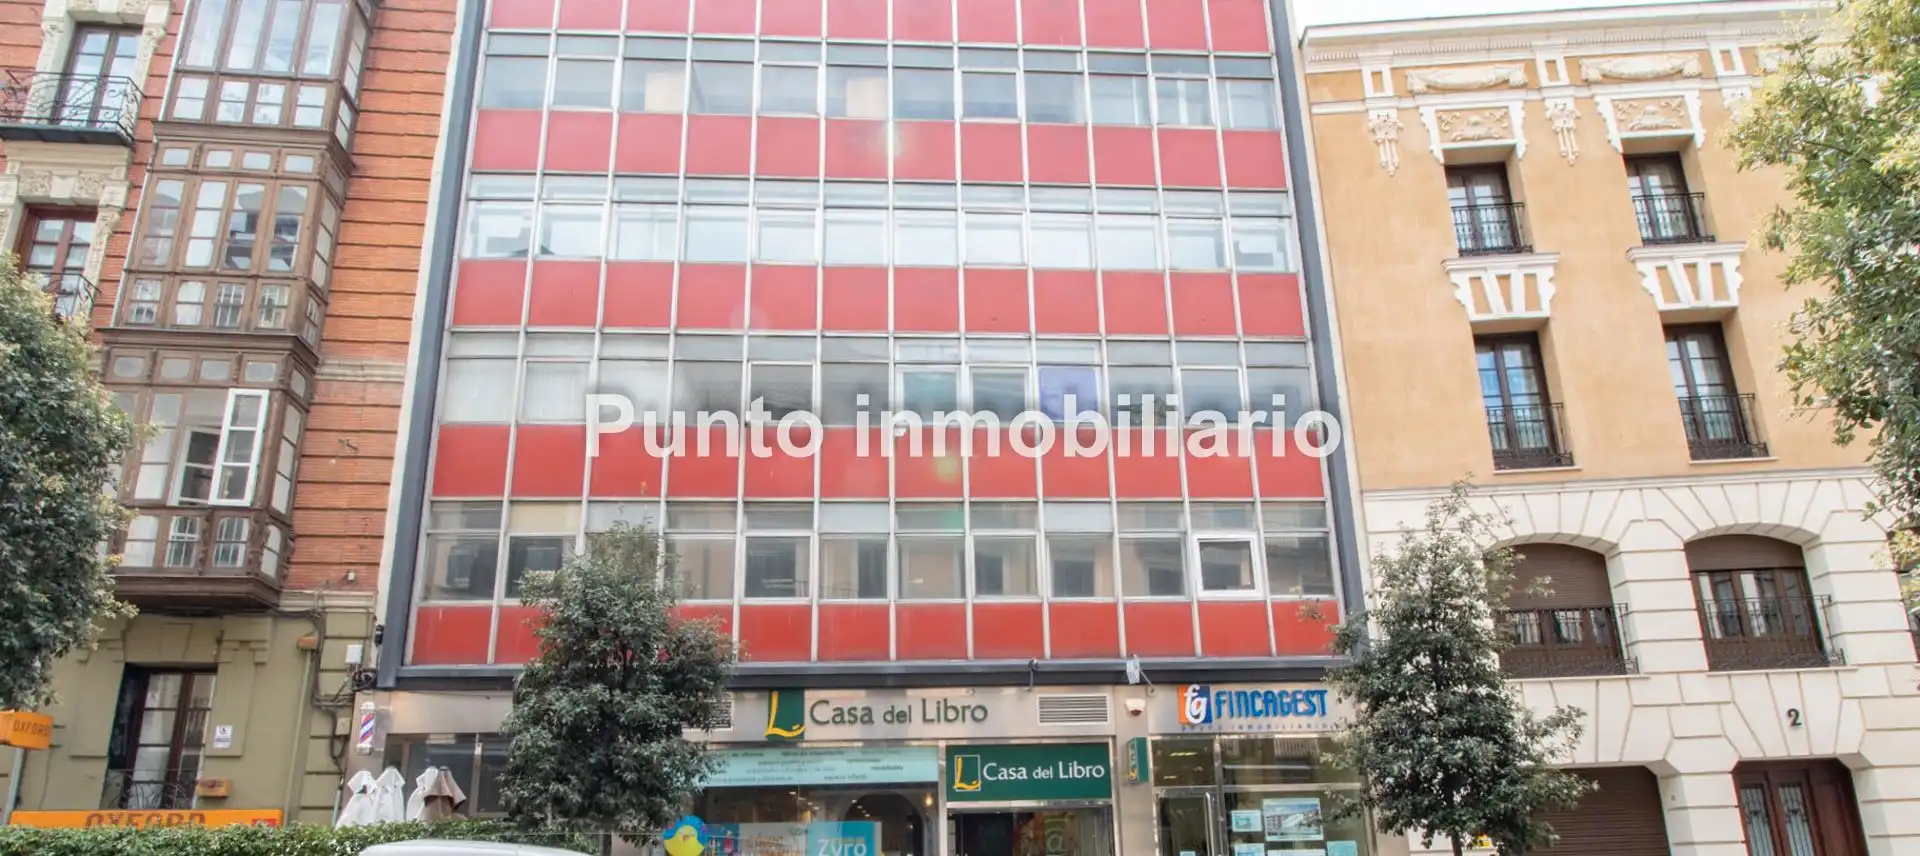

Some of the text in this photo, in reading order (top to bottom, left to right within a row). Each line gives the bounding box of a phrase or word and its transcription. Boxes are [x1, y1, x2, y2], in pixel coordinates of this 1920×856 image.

[809, 699, 874, 726] Casa
[883, 704, 912, 724] del
[921, 697, 988, 723] Libro
[1215, 689, 1328, 719] FINCAGEST
[1786, 707, 1803, 727] 2
[983, 762, 1028, 781] Casa
[1032, 765, 1053, 779] del
[1058, 760, 1105, 779] Libro
